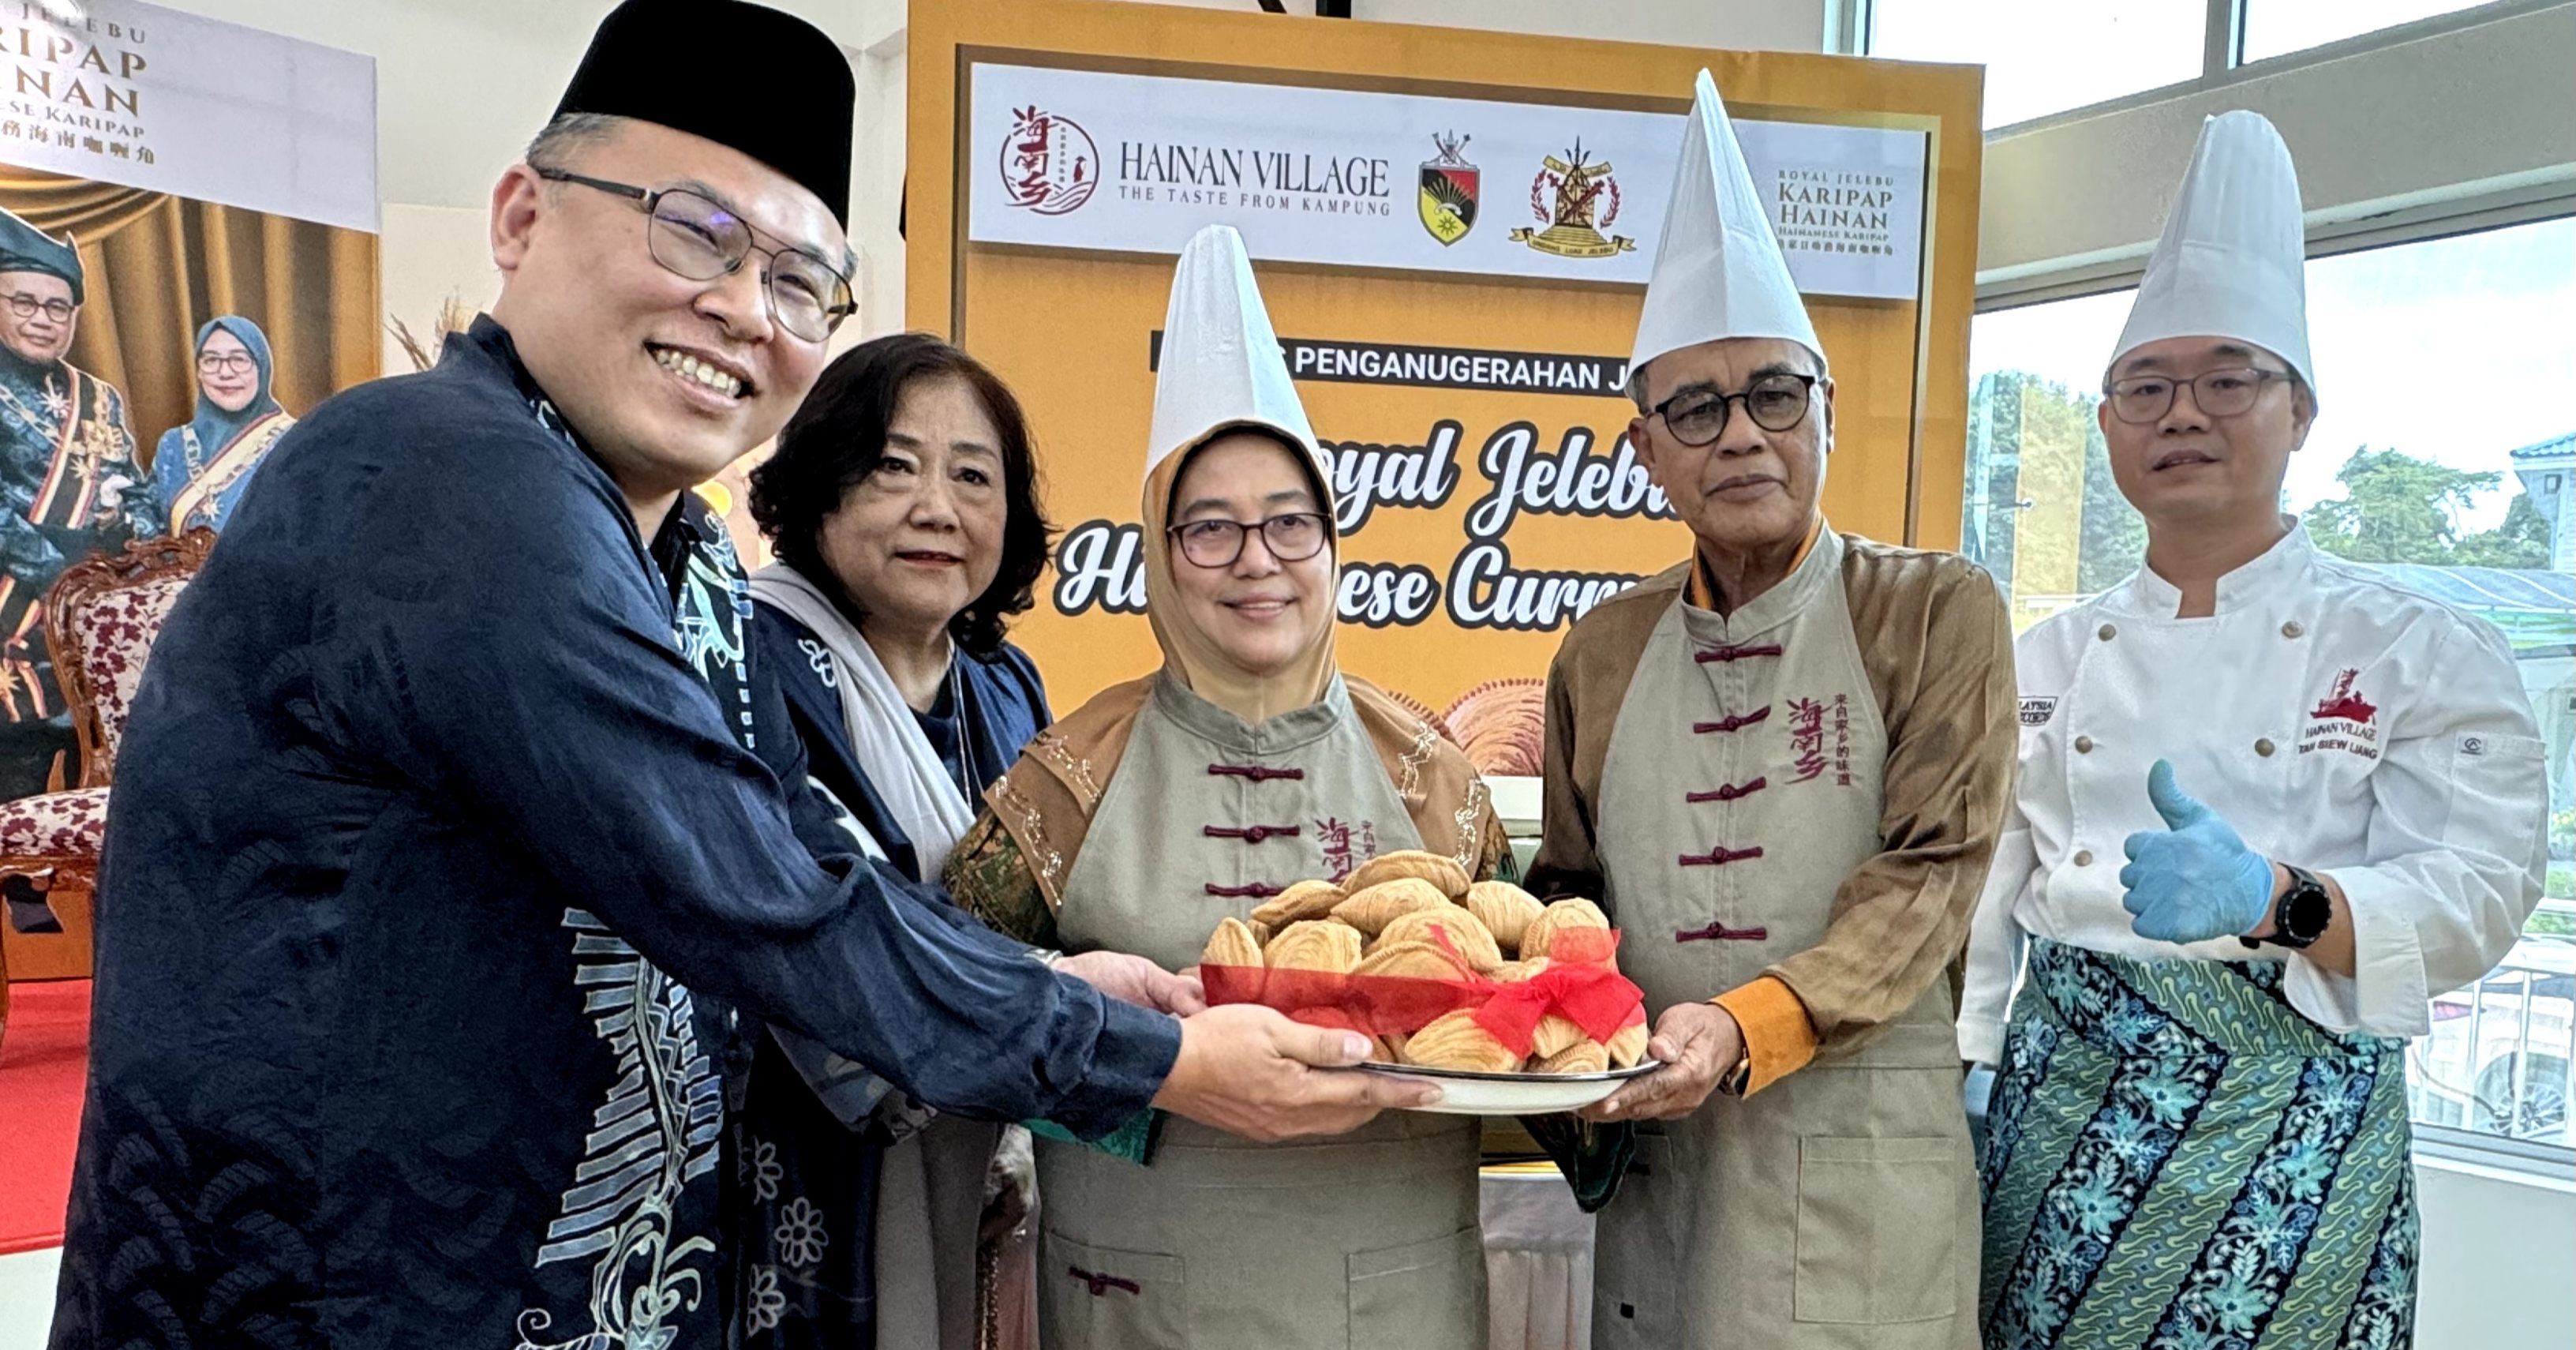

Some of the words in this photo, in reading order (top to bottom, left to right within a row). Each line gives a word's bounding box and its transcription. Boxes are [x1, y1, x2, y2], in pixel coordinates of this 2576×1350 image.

[45, 106, 145, 138] KARIPAP
[1120, 141, 1244, 188] HAINAN
[1252, 150, 1390, 197] VILLAGE
[1779, 170, 1829, 182] ROYAL
[1837, 173, 1894, 186] JELEBU
[1118, 185, 1155, 201] THE
[1167, 188, 1228, 205] TASTE
[1240, 193, 1290, 210] FROM
[1301, 197, 1390, 216] KAMPUNG
[1779, 182, 1893, 208] KARIPAP
[1780, 204, 1888, 230] HAINAN
[1295, 347, 1601, 389] PENGANUGERAHAN
[1453, 545, 1638, 625] Curr
[2317, 739, 2349, 750] SIEW
